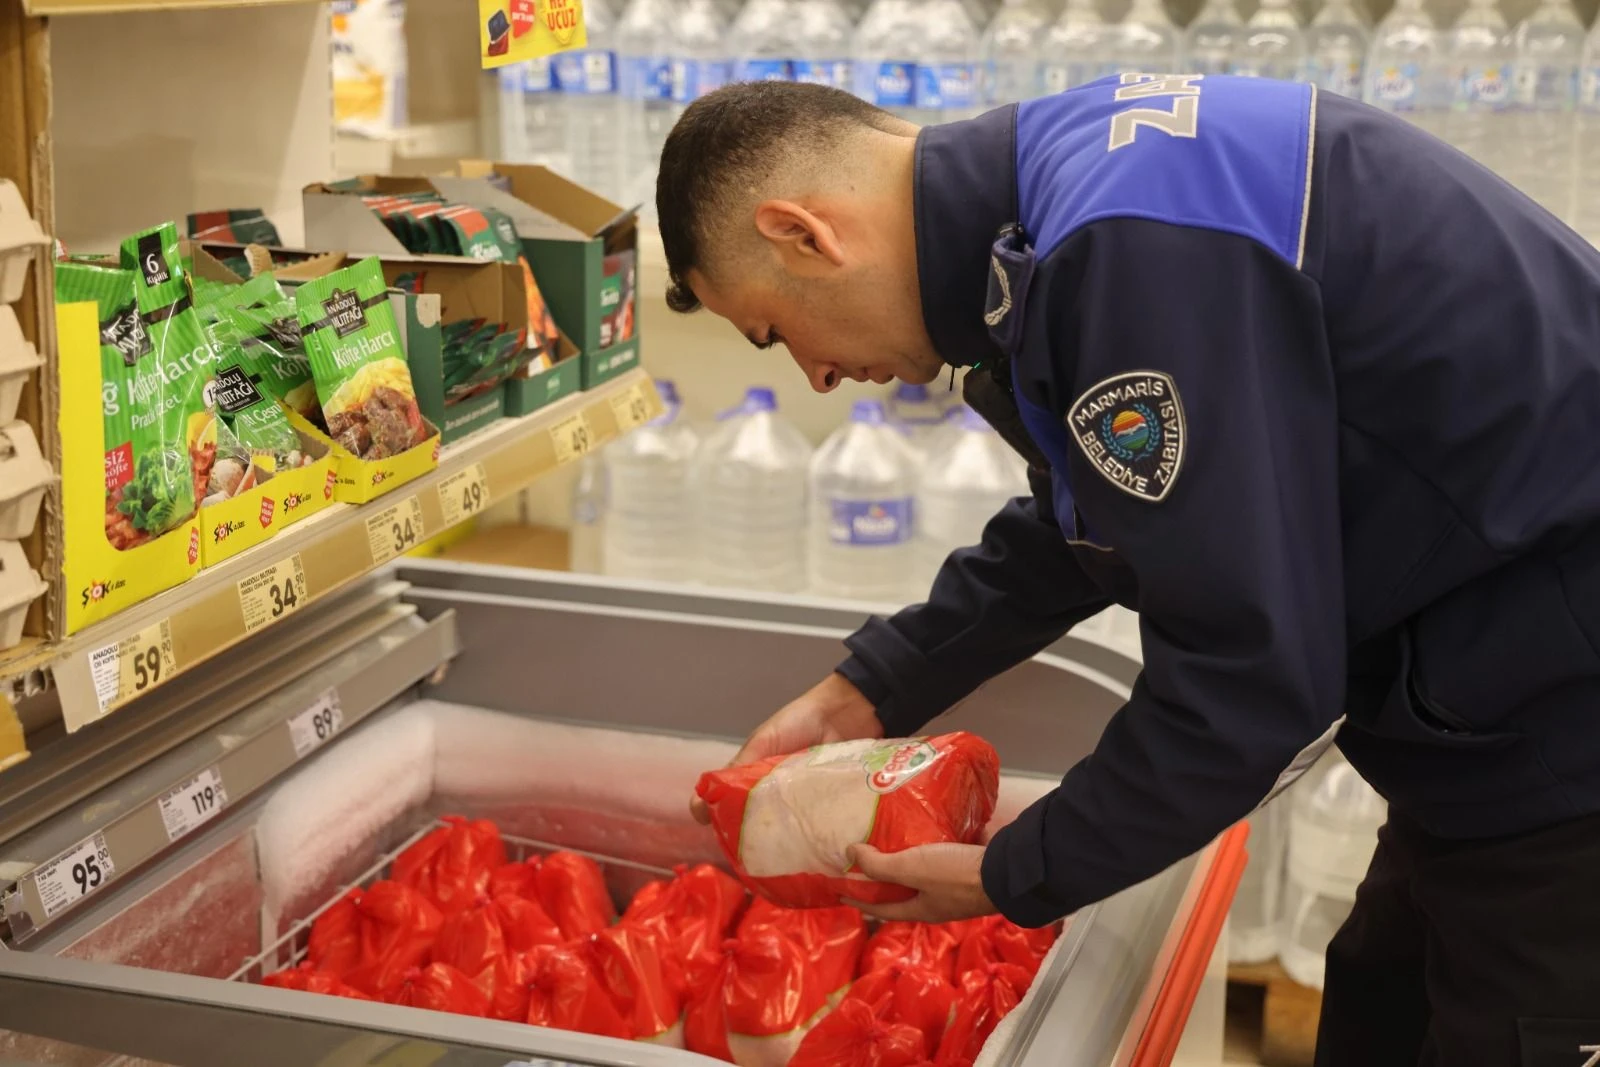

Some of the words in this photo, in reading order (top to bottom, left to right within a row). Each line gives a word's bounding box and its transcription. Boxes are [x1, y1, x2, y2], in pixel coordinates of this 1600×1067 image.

[547, 8, 576, 31] UCUZ
[146, 253, 159, 274] 6
[326, 296, 356, 314] ANADOLU
[332, 344, 362, 370] Köfte
[357, 331, 396, 358] Harcı
[1075, 378, 1164, 427] MARMARİS
[1153, 399, 1180, 486] ZABITASI
[1082, 430, 1149, 493] BELEDİYE
[463, 481, 481, 512] 49
[392, 517, 416, 552] 34
[269, 577, 298, 617] 34
[133, 645, 161, 691] 59
[313, 708, 333, 740] 89
[191, 785, 215, 815] 119
[72, 854, 102, 895] 95
[97, 847, 109, 861] 00
